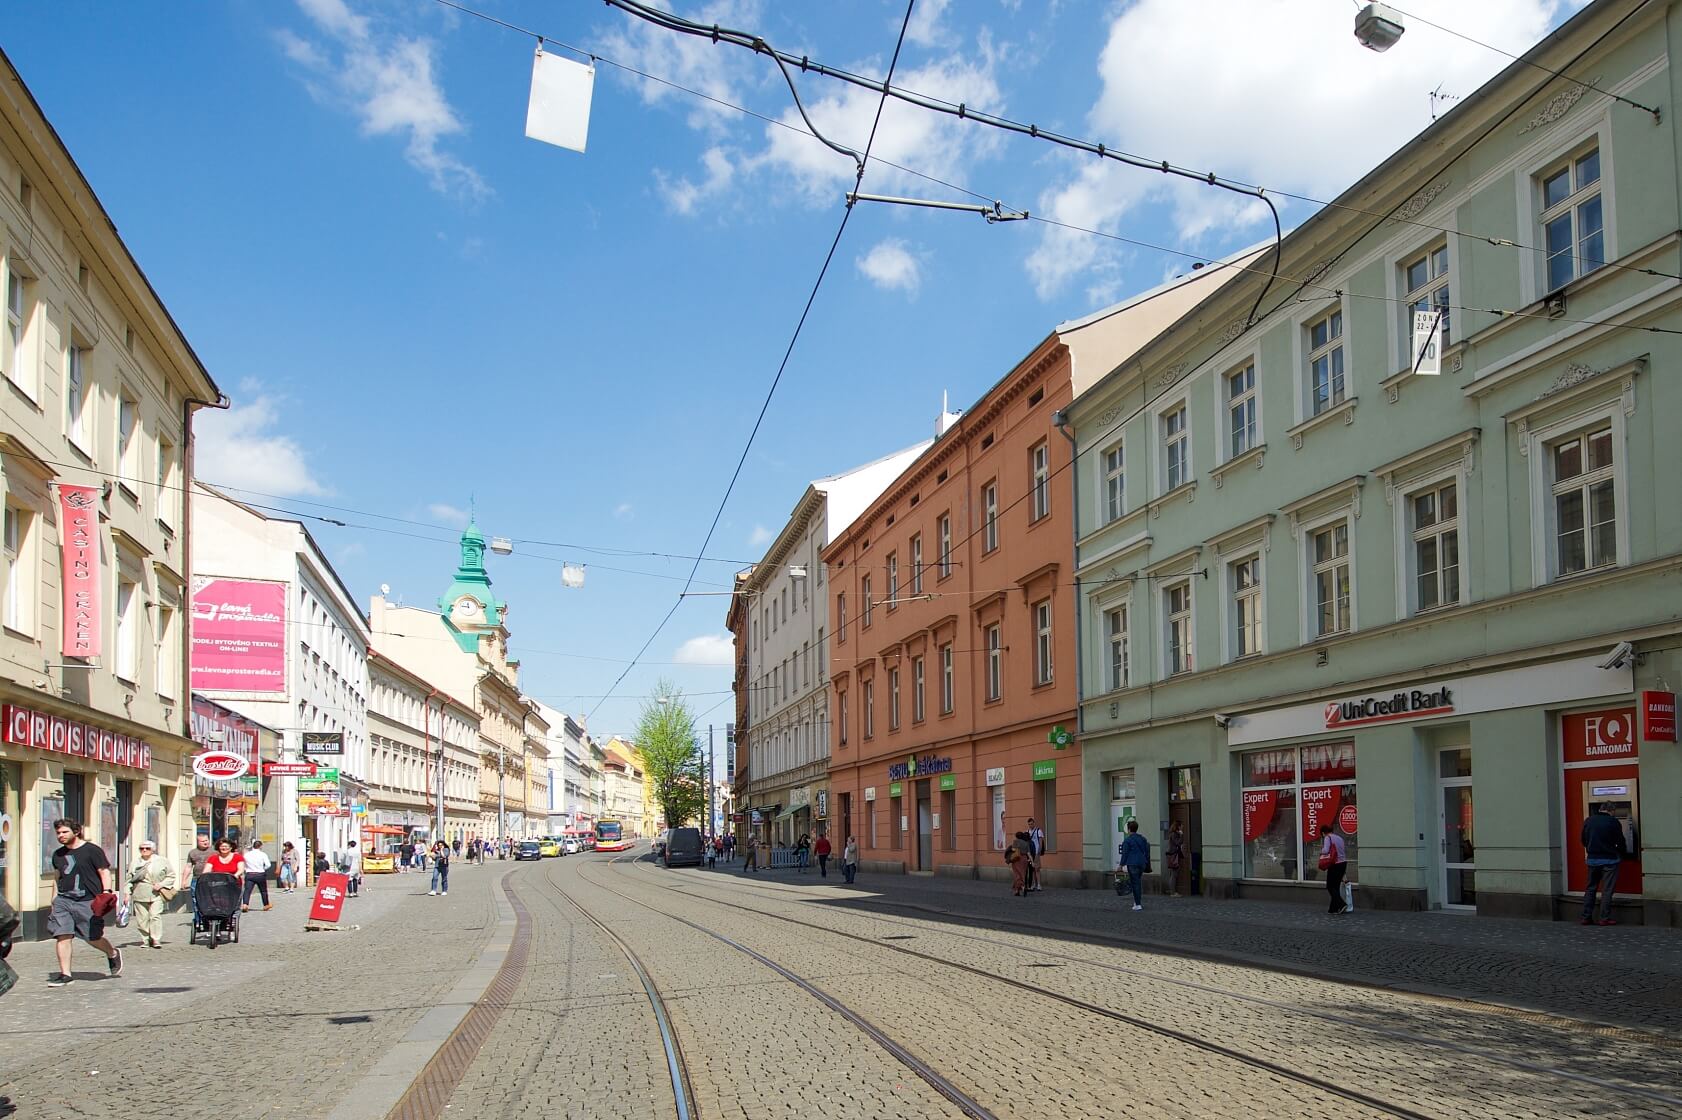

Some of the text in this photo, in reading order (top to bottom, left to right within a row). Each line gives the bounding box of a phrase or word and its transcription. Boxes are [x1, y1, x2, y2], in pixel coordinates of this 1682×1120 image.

[73, 517, 88, 578] CASINO
[1342, 686, 1453, 720] UniCredit Bank
[1585, 743, 1632, 756] BANKOMAT
[1243, 792, 1269, 804] Expert
[1303, 788, 1332, 801] Expert
